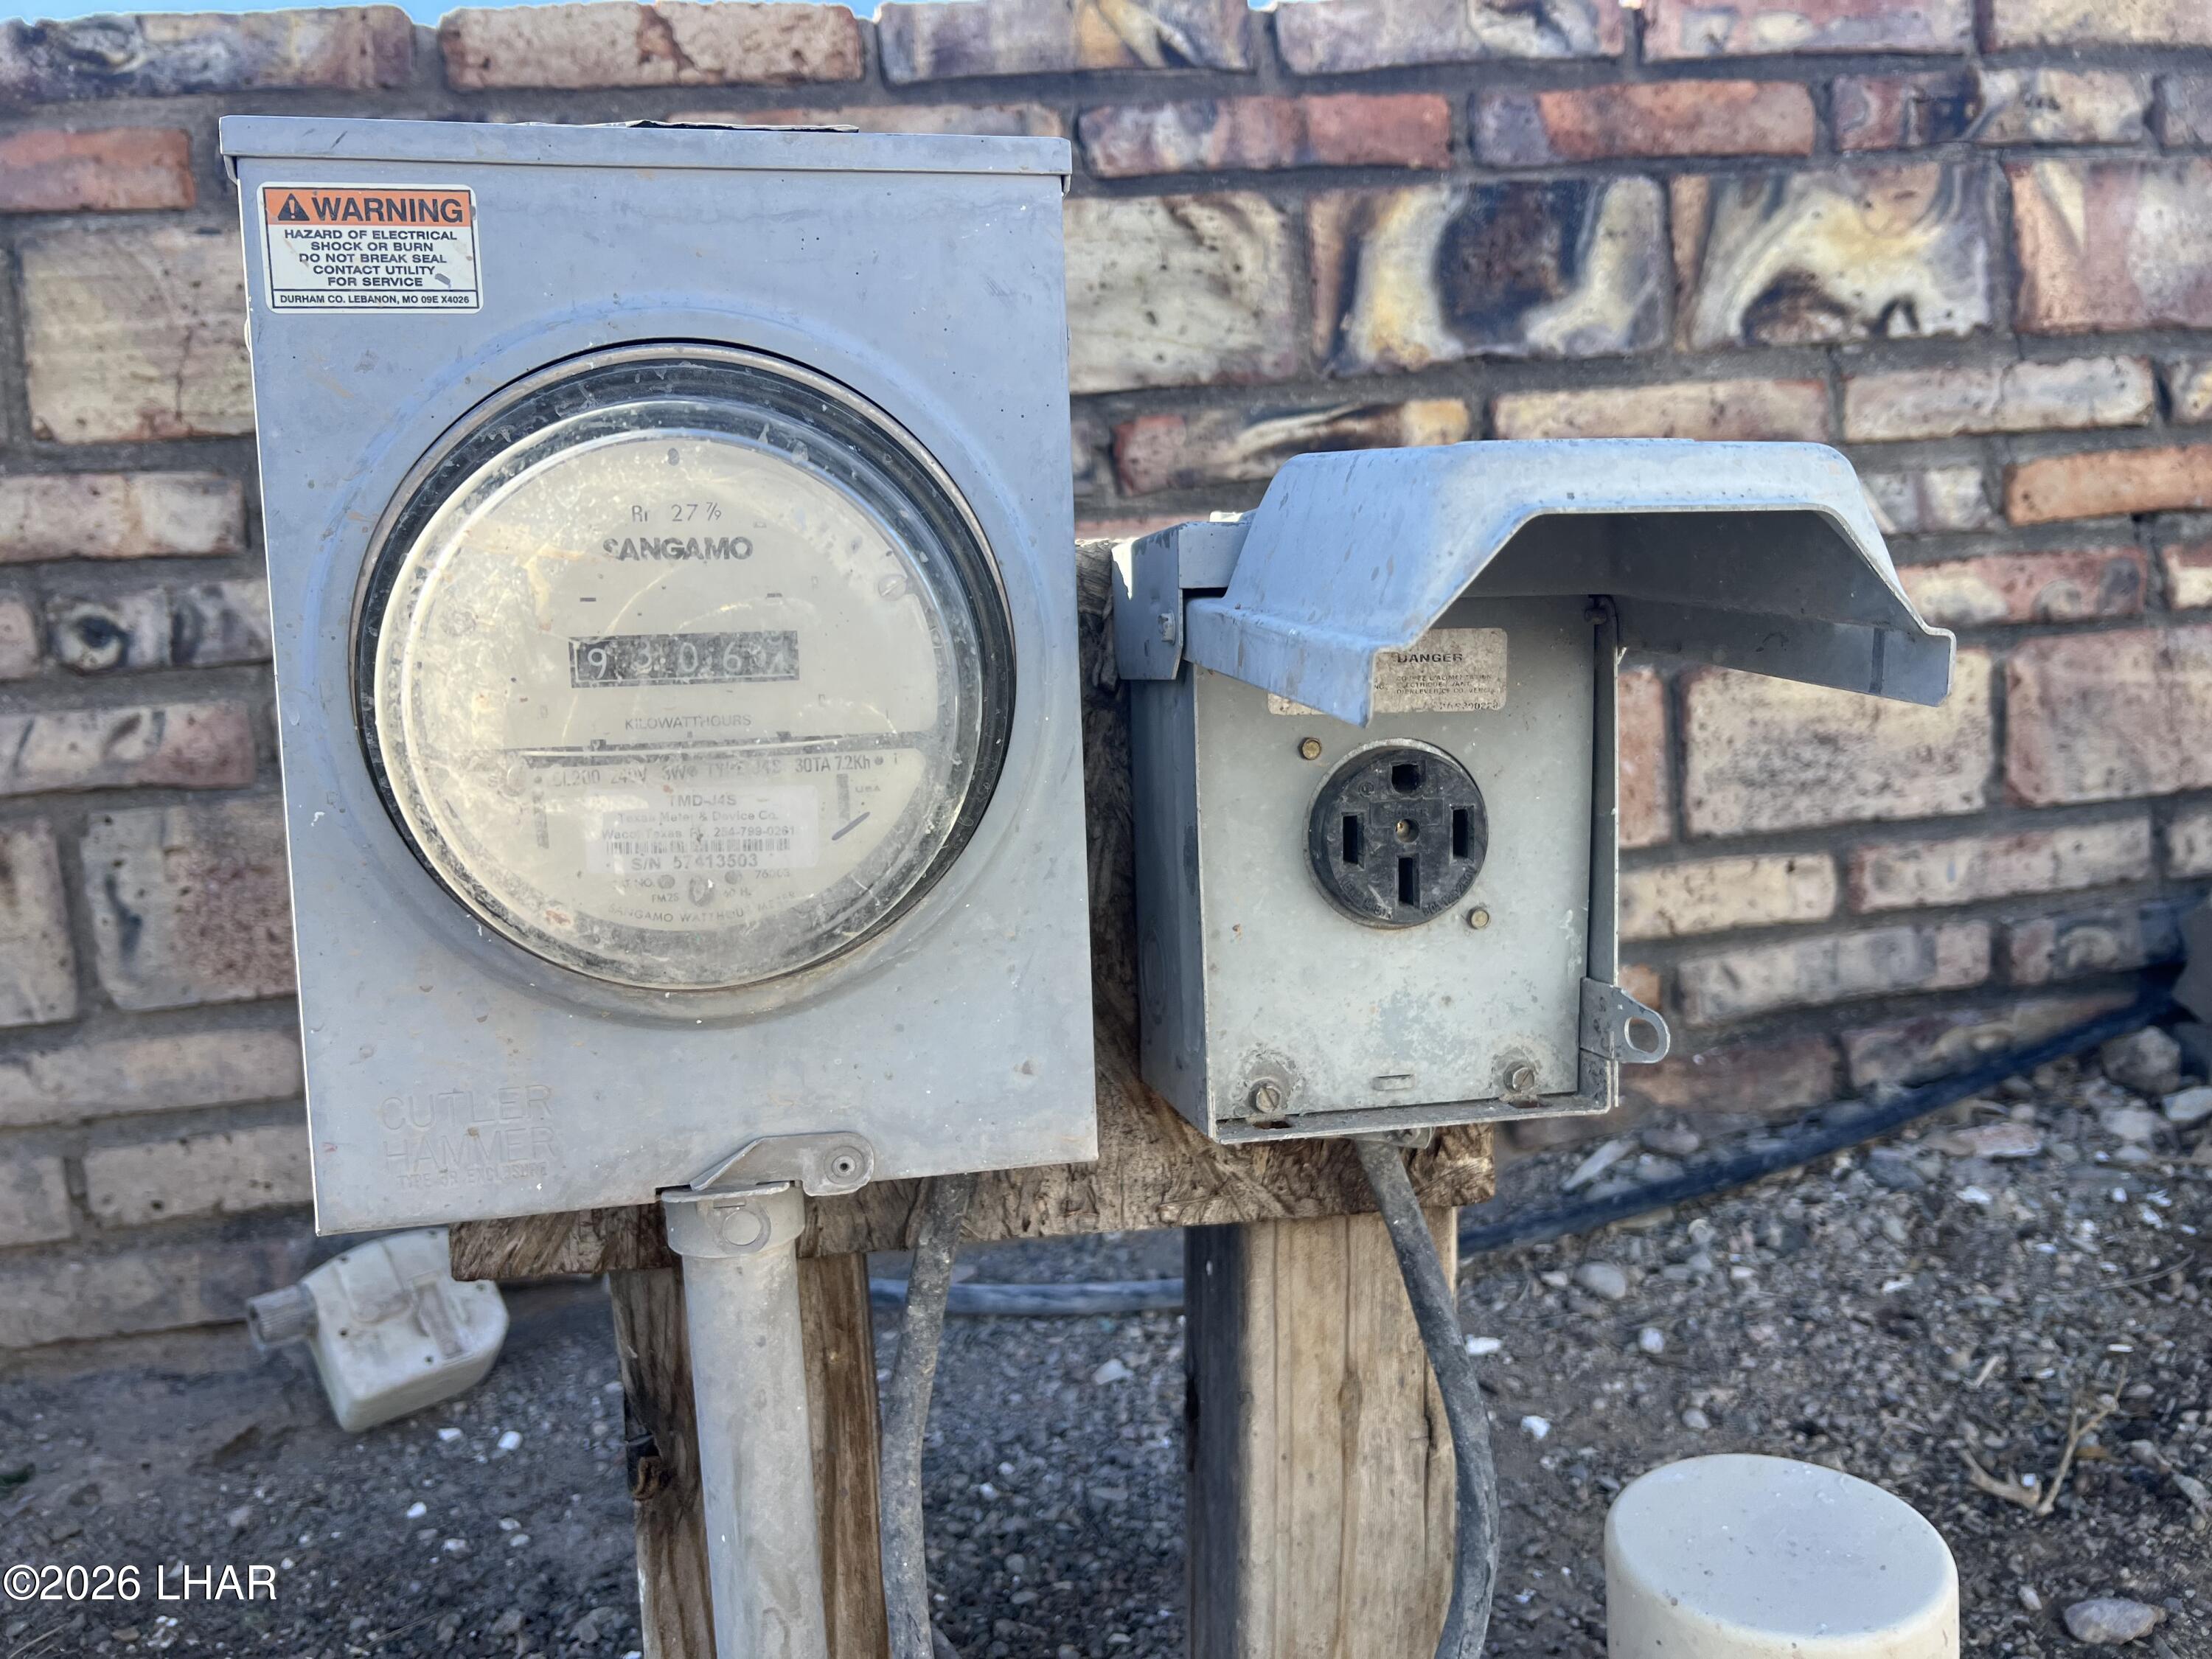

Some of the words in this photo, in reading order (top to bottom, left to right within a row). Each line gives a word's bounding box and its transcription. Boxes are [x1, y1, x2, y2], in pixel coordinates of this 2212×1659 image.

[311, 196, 464, 223] WARNING
[284, 229, 343, 240] HAZARD
[347, 230, 367, 240] OF
[372, 231, 457, 240] ELECTRICAL
[310, 241, 363, 251] SHOCK
[366, 242, 388, 251] OR
[393, 243, 434, 252] BURN
[299, 253, 320, 263] DO
[325, 253, 355, 263] NOT
[360, 254, 408, 263] BREAK
[412, 254, 447, 264] SEAL
[313, 265, 380, 275] CONTACT
[386, 265, 435, 275] UTILITY
[327, 277, 357, 287] FOR
[362, 277, 423, 287] SERVICE
[279, 294, 325, 304] DURHAM
[327, 295, 346, 304] CO.
[348, 295, 400, 305] LEBANON,
[402, 296, 418, 305] MO
[420, 296, 439, 305] 09E
[441, 296, 470, 305] X4026
[670, 504, 699, 522] 27
[602, 536, 754, 561] SANGAMO
[1397, 653, 1463, 663] DANGER
[625, 714, 752, 731] KILOWATTHOURS
[631, 856, 662, 871] S/N
[381, 1084, 552, 1130] CUTLER
[382, 1126, 556, 1172] HAMMER
